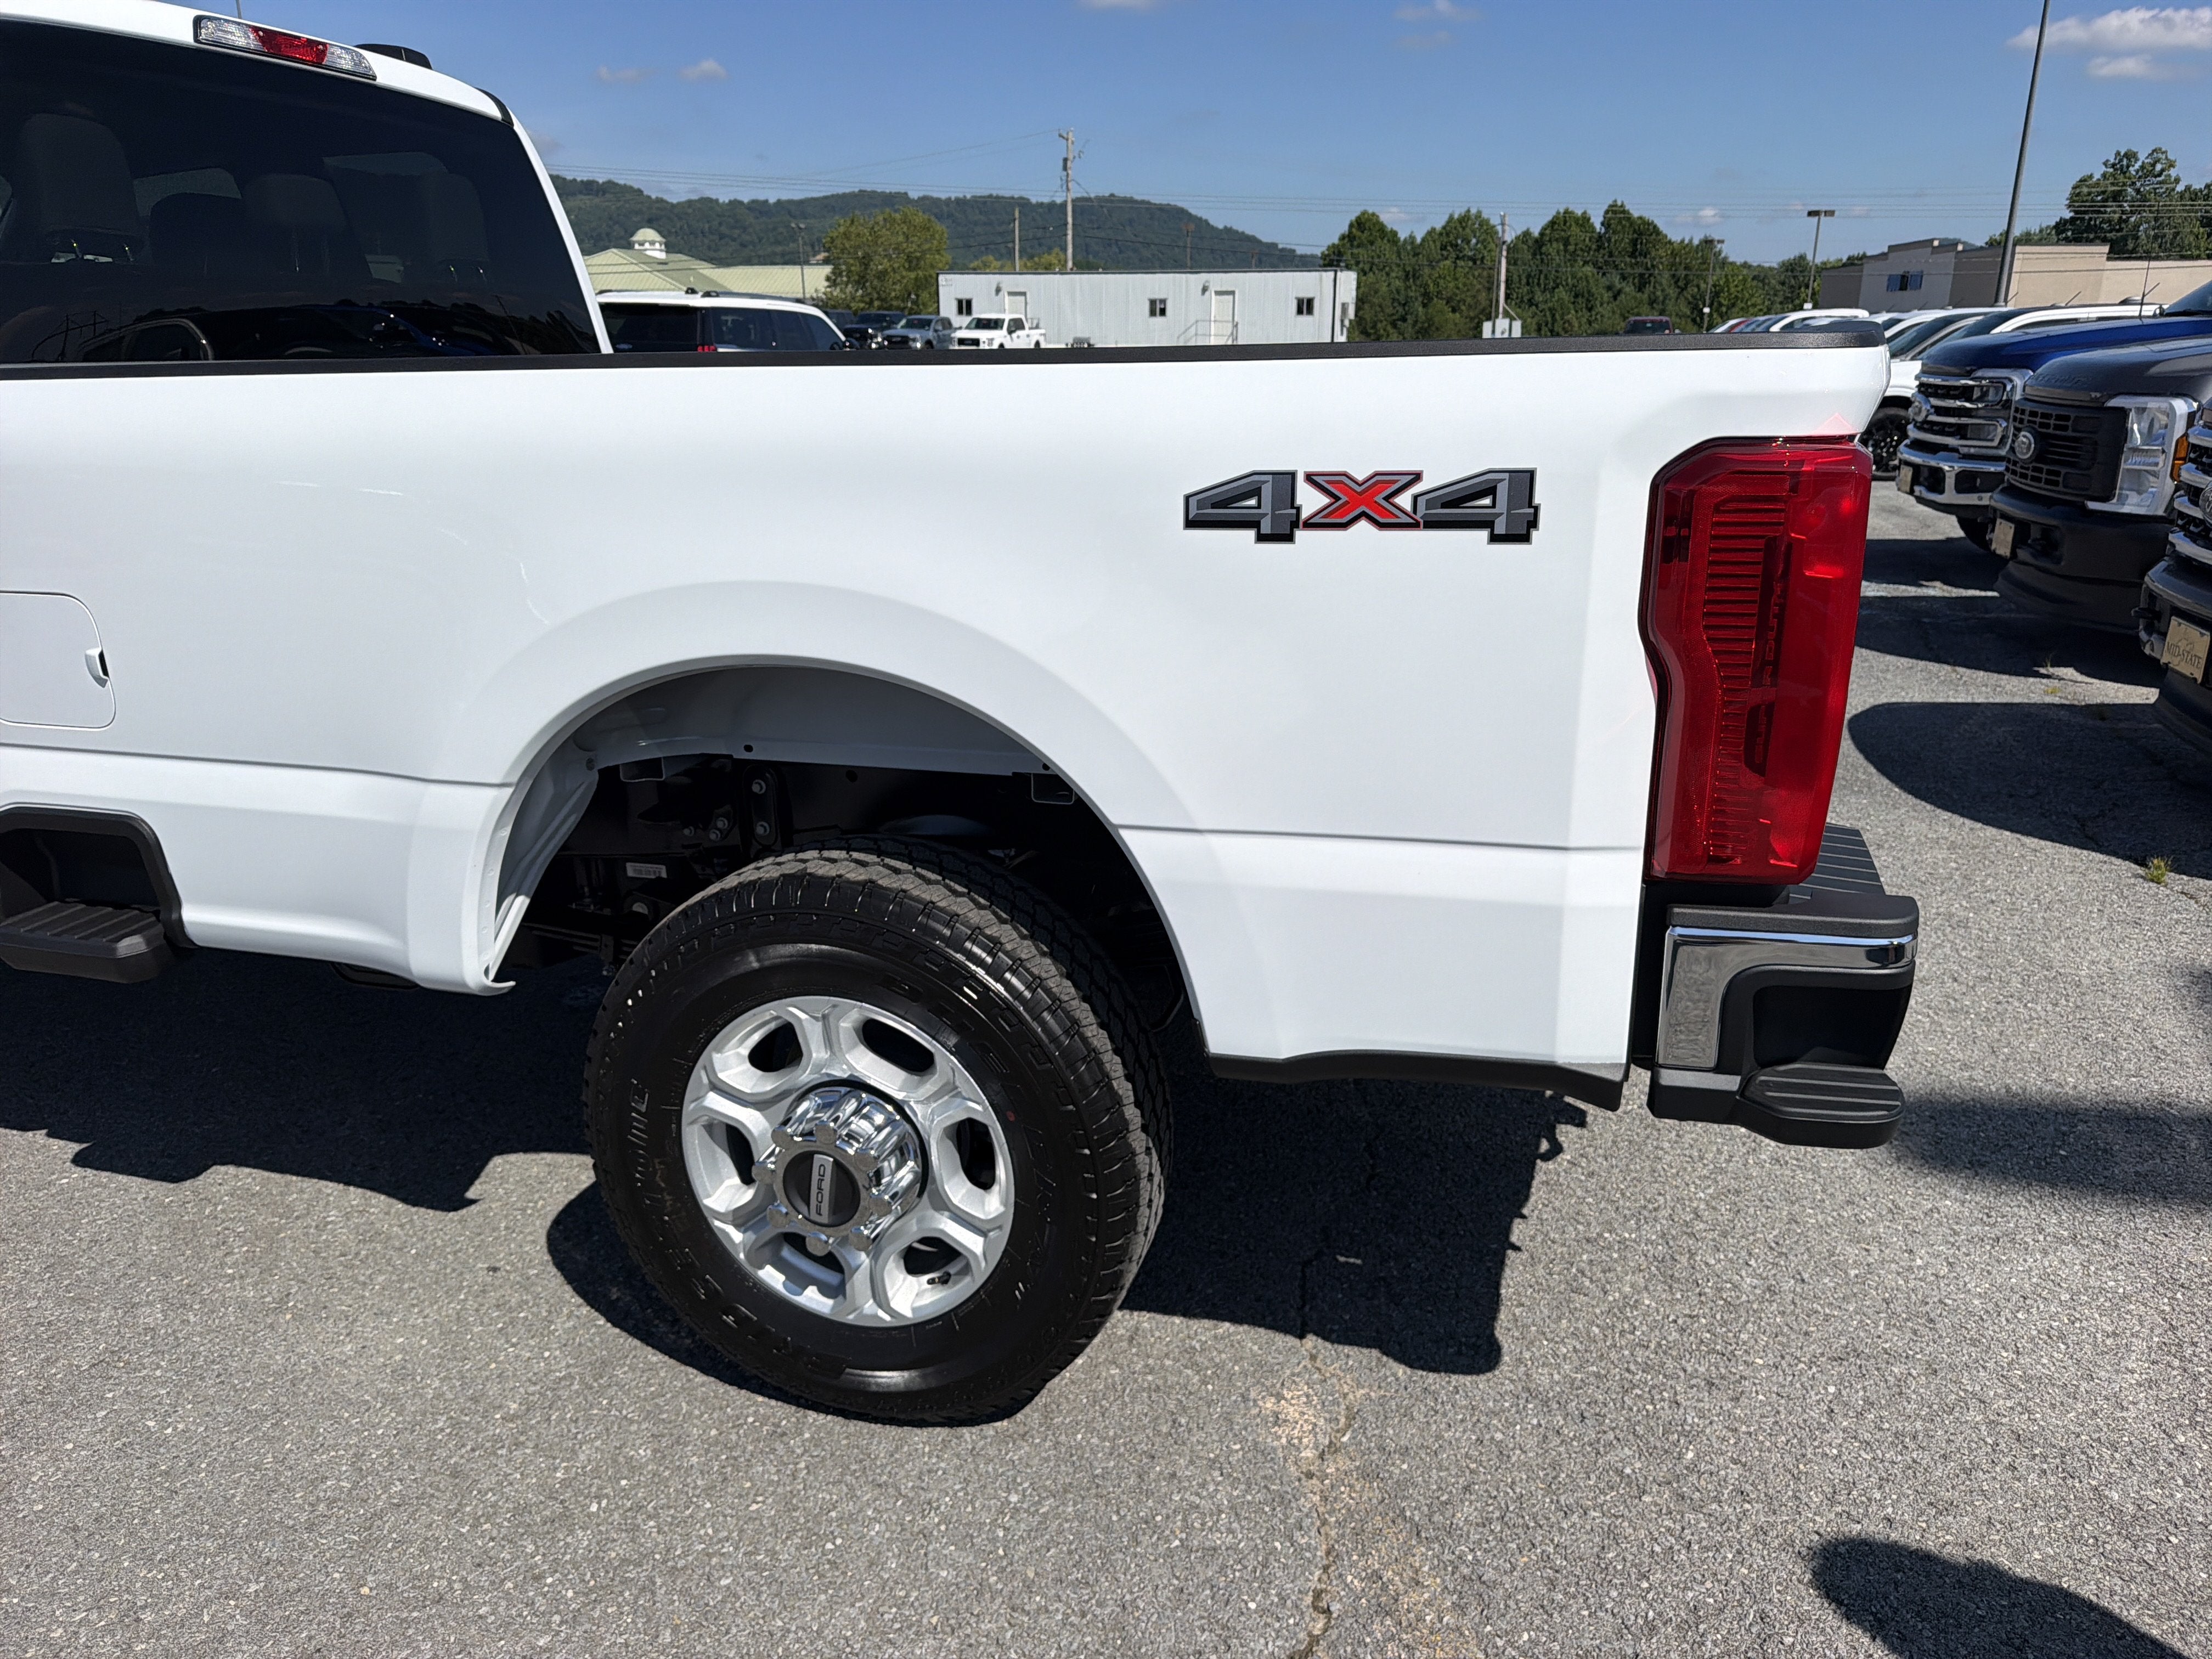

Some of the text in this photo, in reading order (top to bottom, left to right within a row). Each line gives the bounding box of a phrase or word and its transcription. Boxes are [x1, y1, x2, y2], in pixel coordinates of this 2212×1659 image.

[1183, 467, 1541, 545] 4X4
[2166, 641, 2202, 668] MID-STATE
[815, 1163, 826, 1216] FORD
